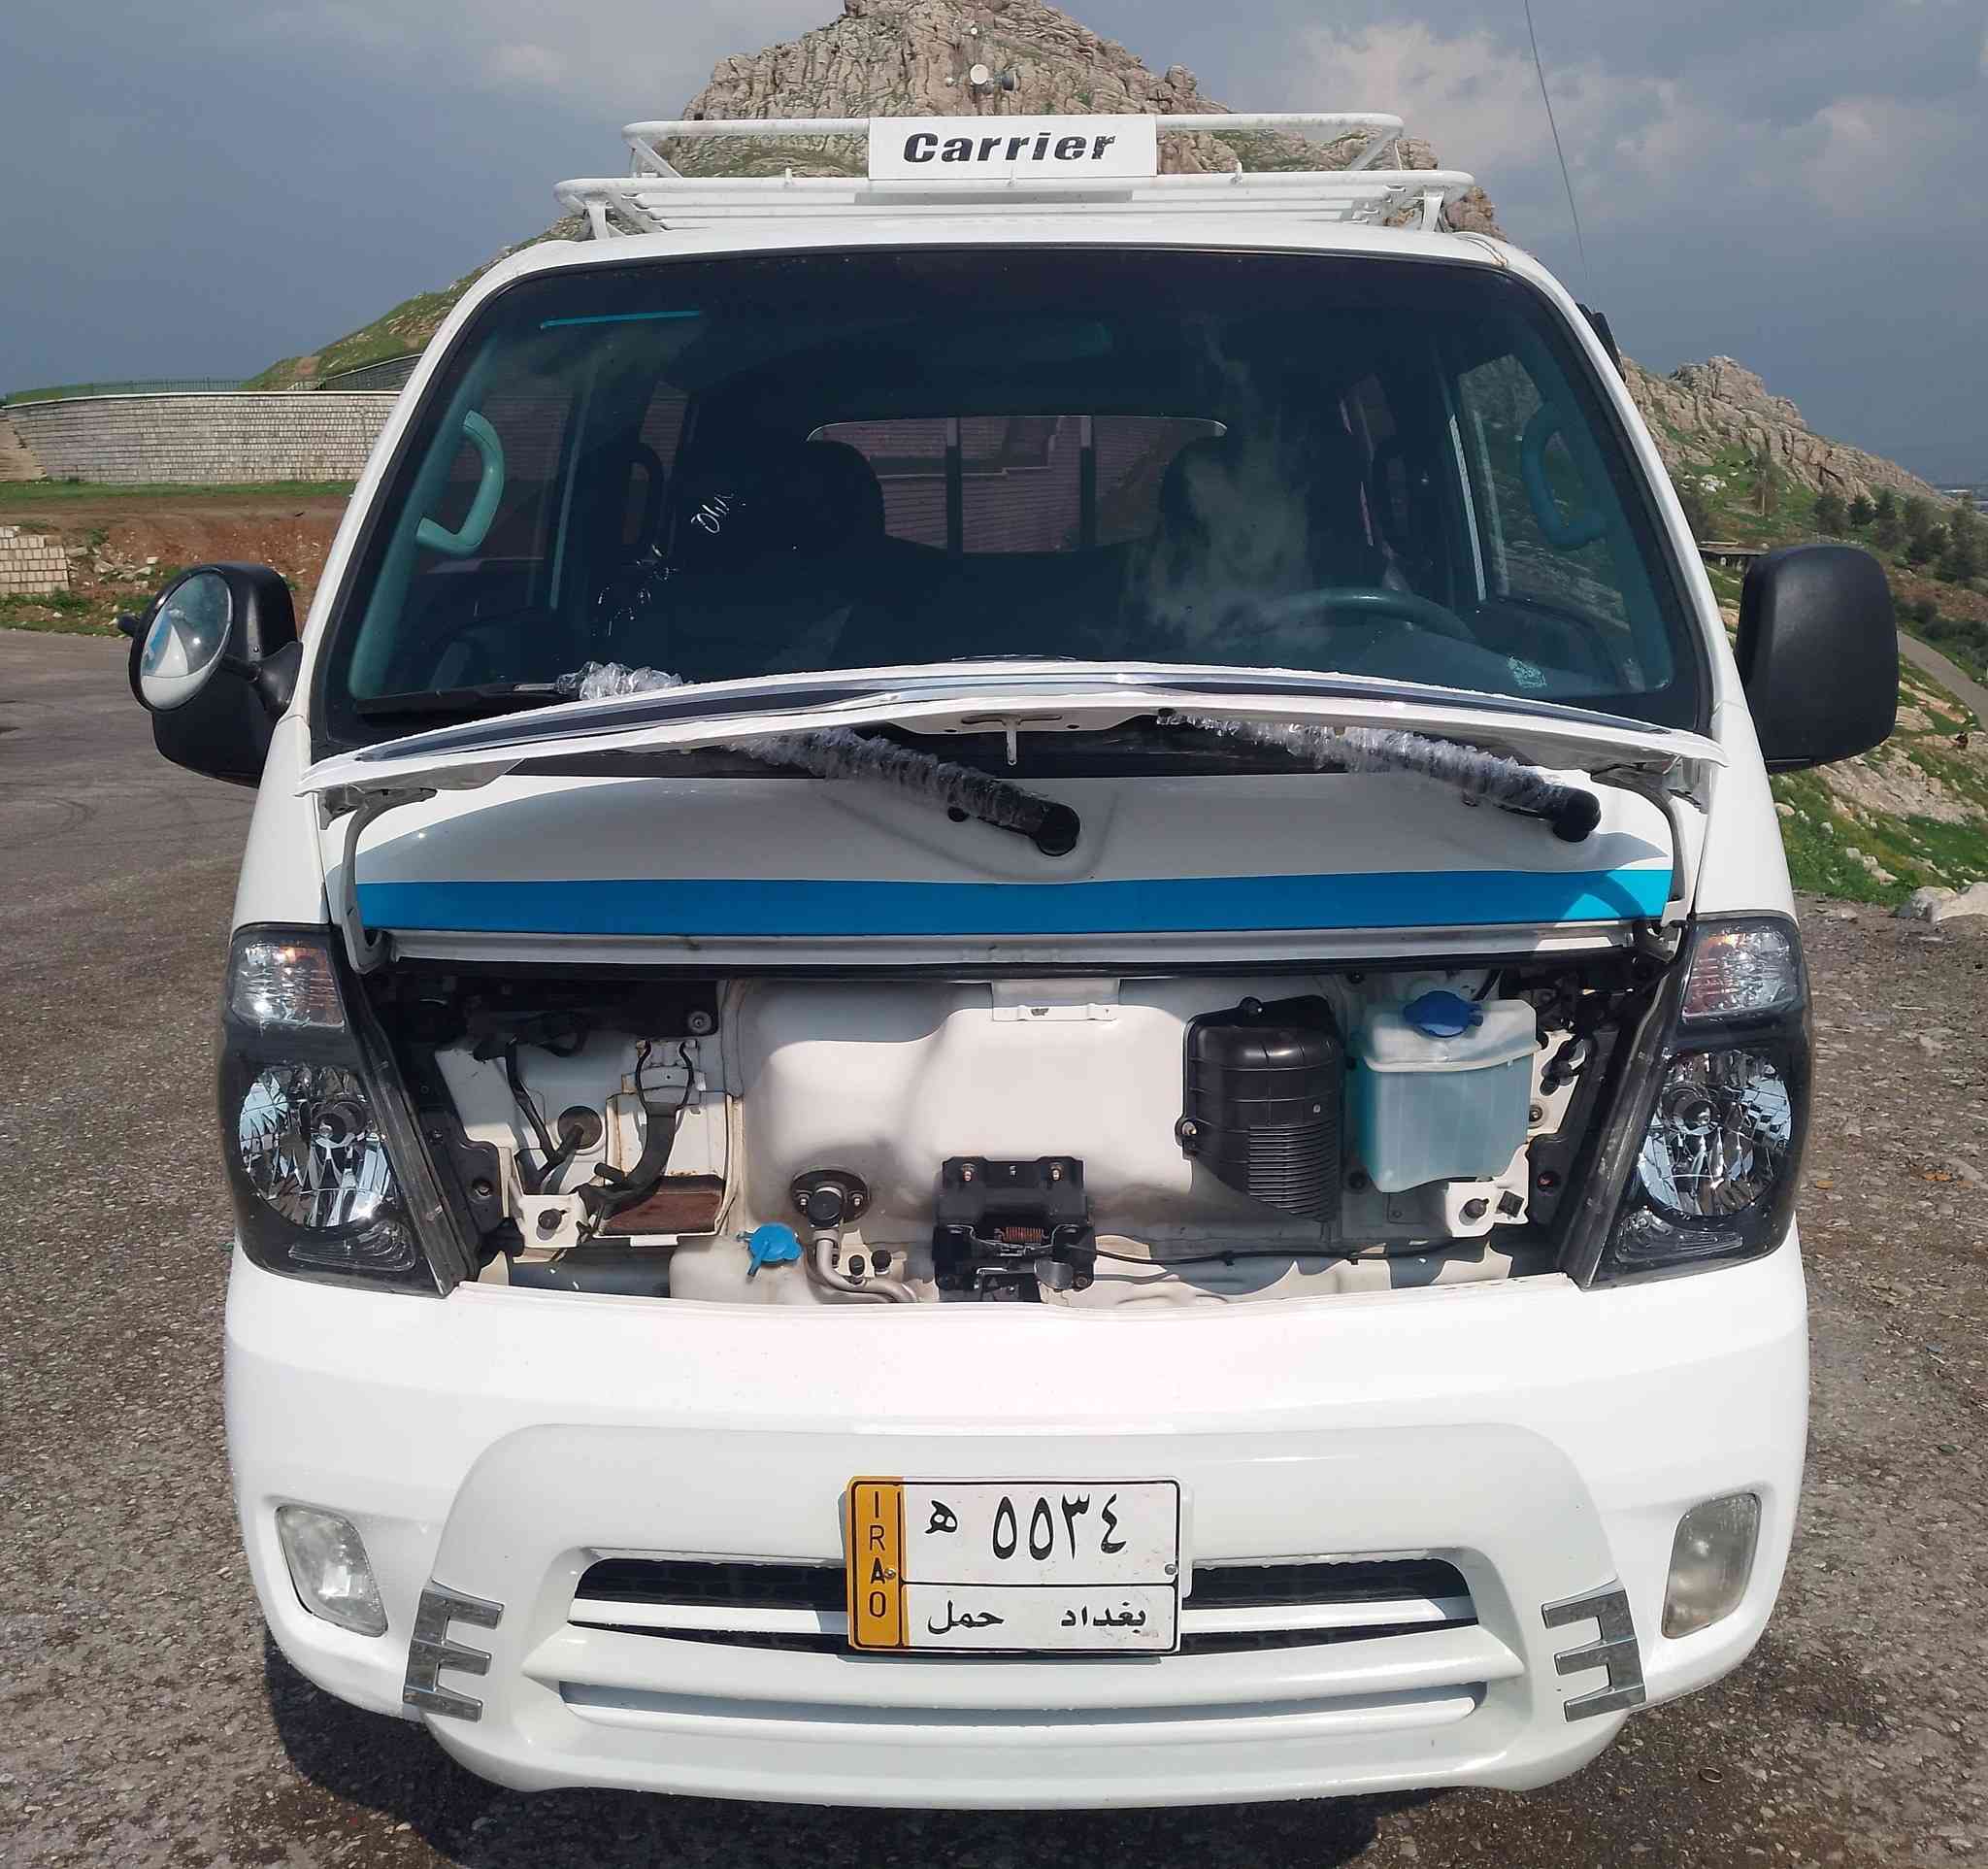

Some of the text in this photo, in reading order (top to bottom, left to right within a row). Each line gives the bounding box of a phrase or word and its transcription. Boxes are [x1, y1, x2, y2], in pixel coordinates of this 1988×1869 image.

[902, 131, 1116, 163] Carrier
[992, 1492, 1127, 1561] ٥٥٣٤
[927, 1599, 1147, 1635] بغداد حمل
